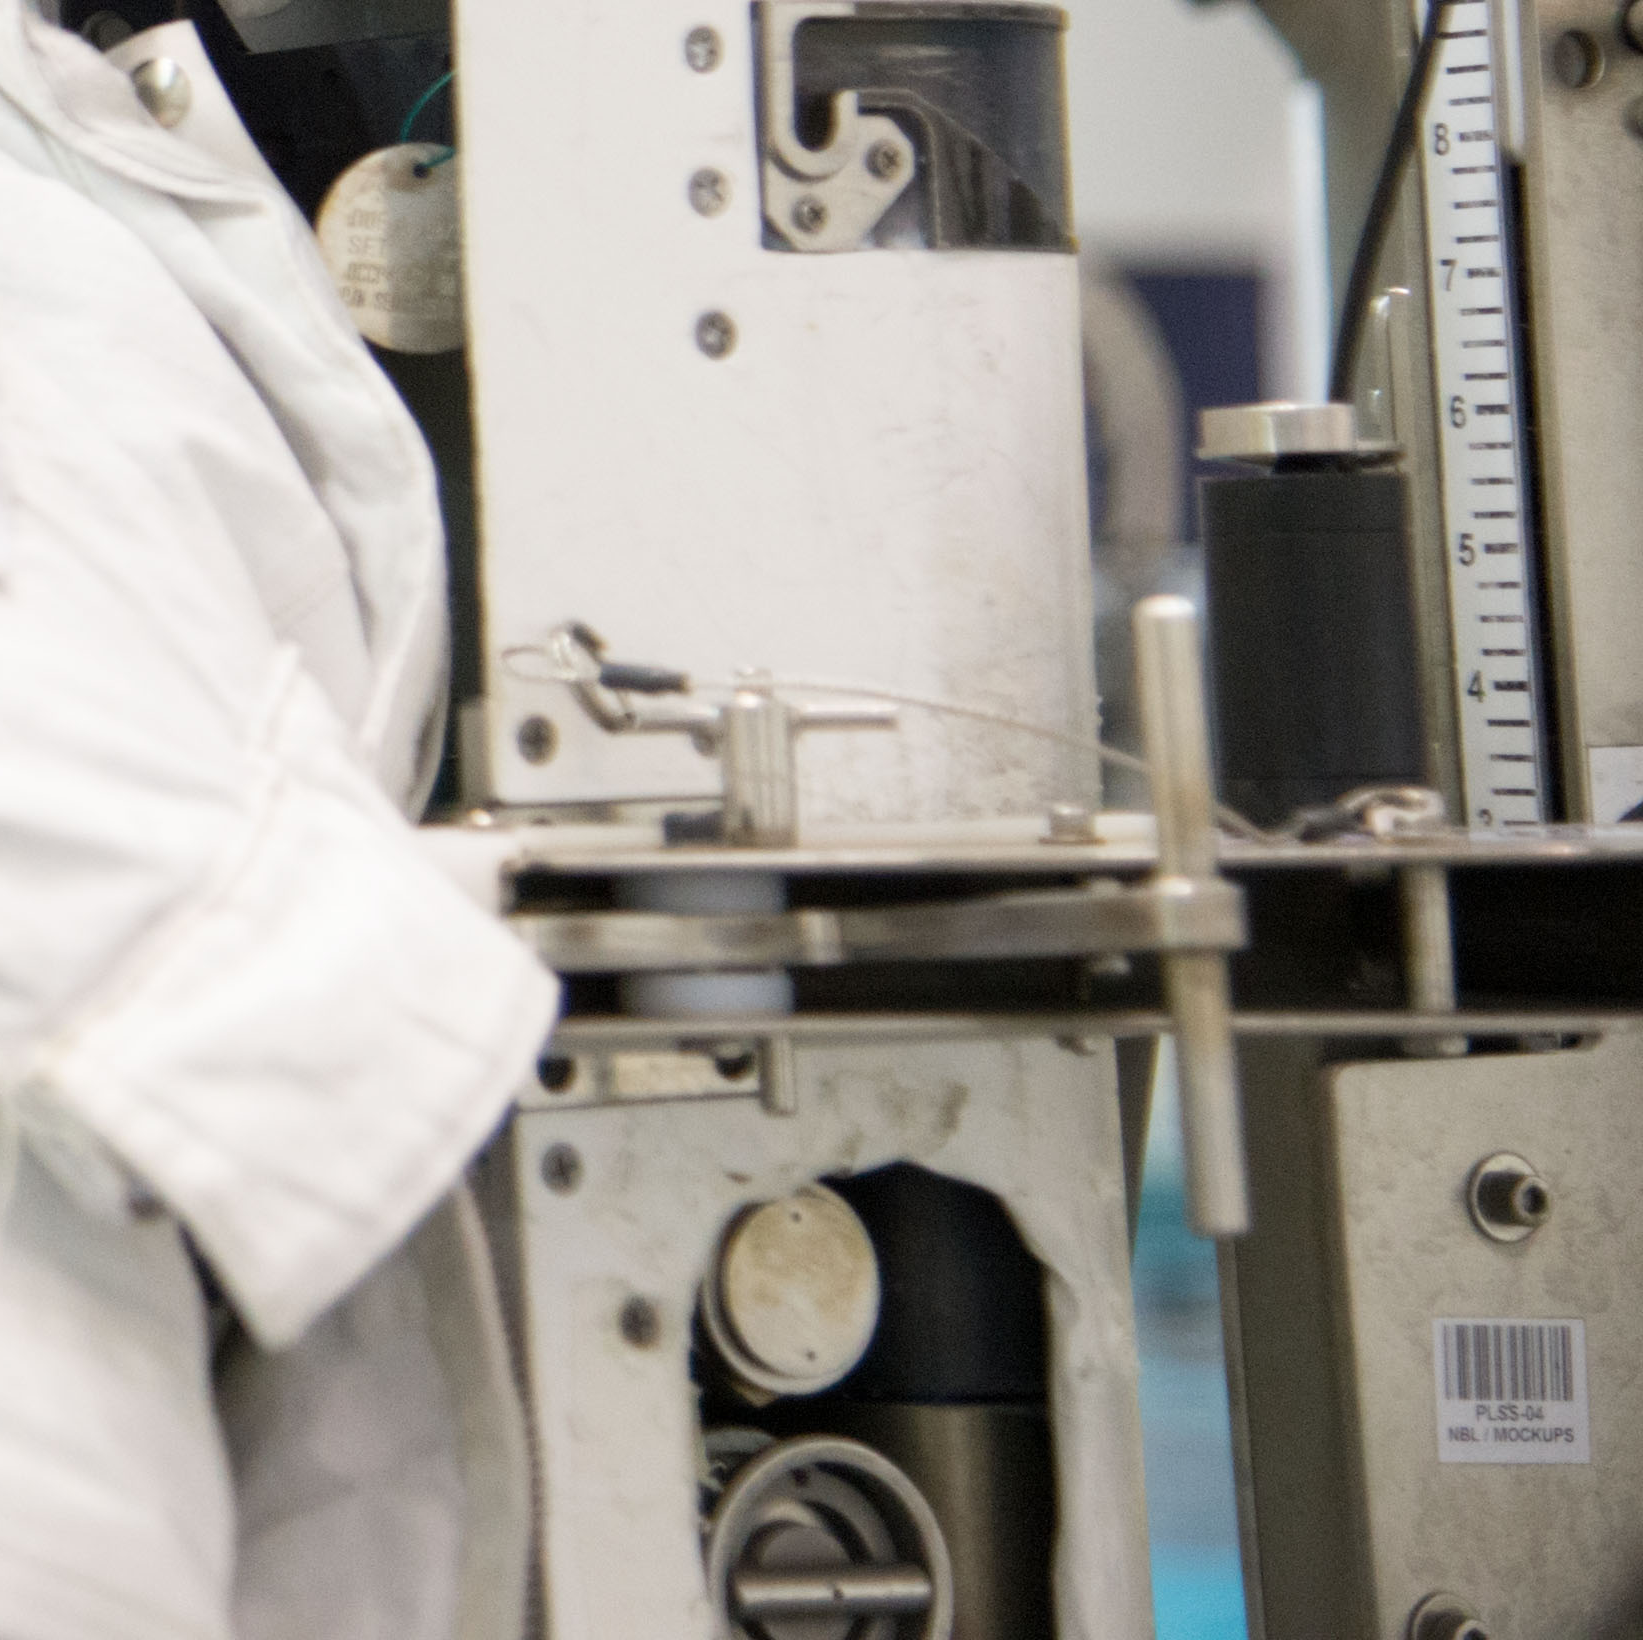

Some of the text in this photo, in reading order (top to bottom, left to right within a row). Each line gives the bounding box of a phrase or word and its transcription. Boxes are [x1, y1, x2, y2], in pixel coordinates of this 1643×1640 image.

[1433, 122, 1450, 156] 8
[1439, 259, 1457, 292] 7
[1450, 395, 1467, 429] 6
[1458, 533, 1476, 567] 5
[1467, 670, 1486, 703] 4
[1475, 1404, 1545, 1423] PLSS-04
[1448, 1427, 1480, 1443] NBL
[1494, 1426, 1576, 1444] MOCKUPS
